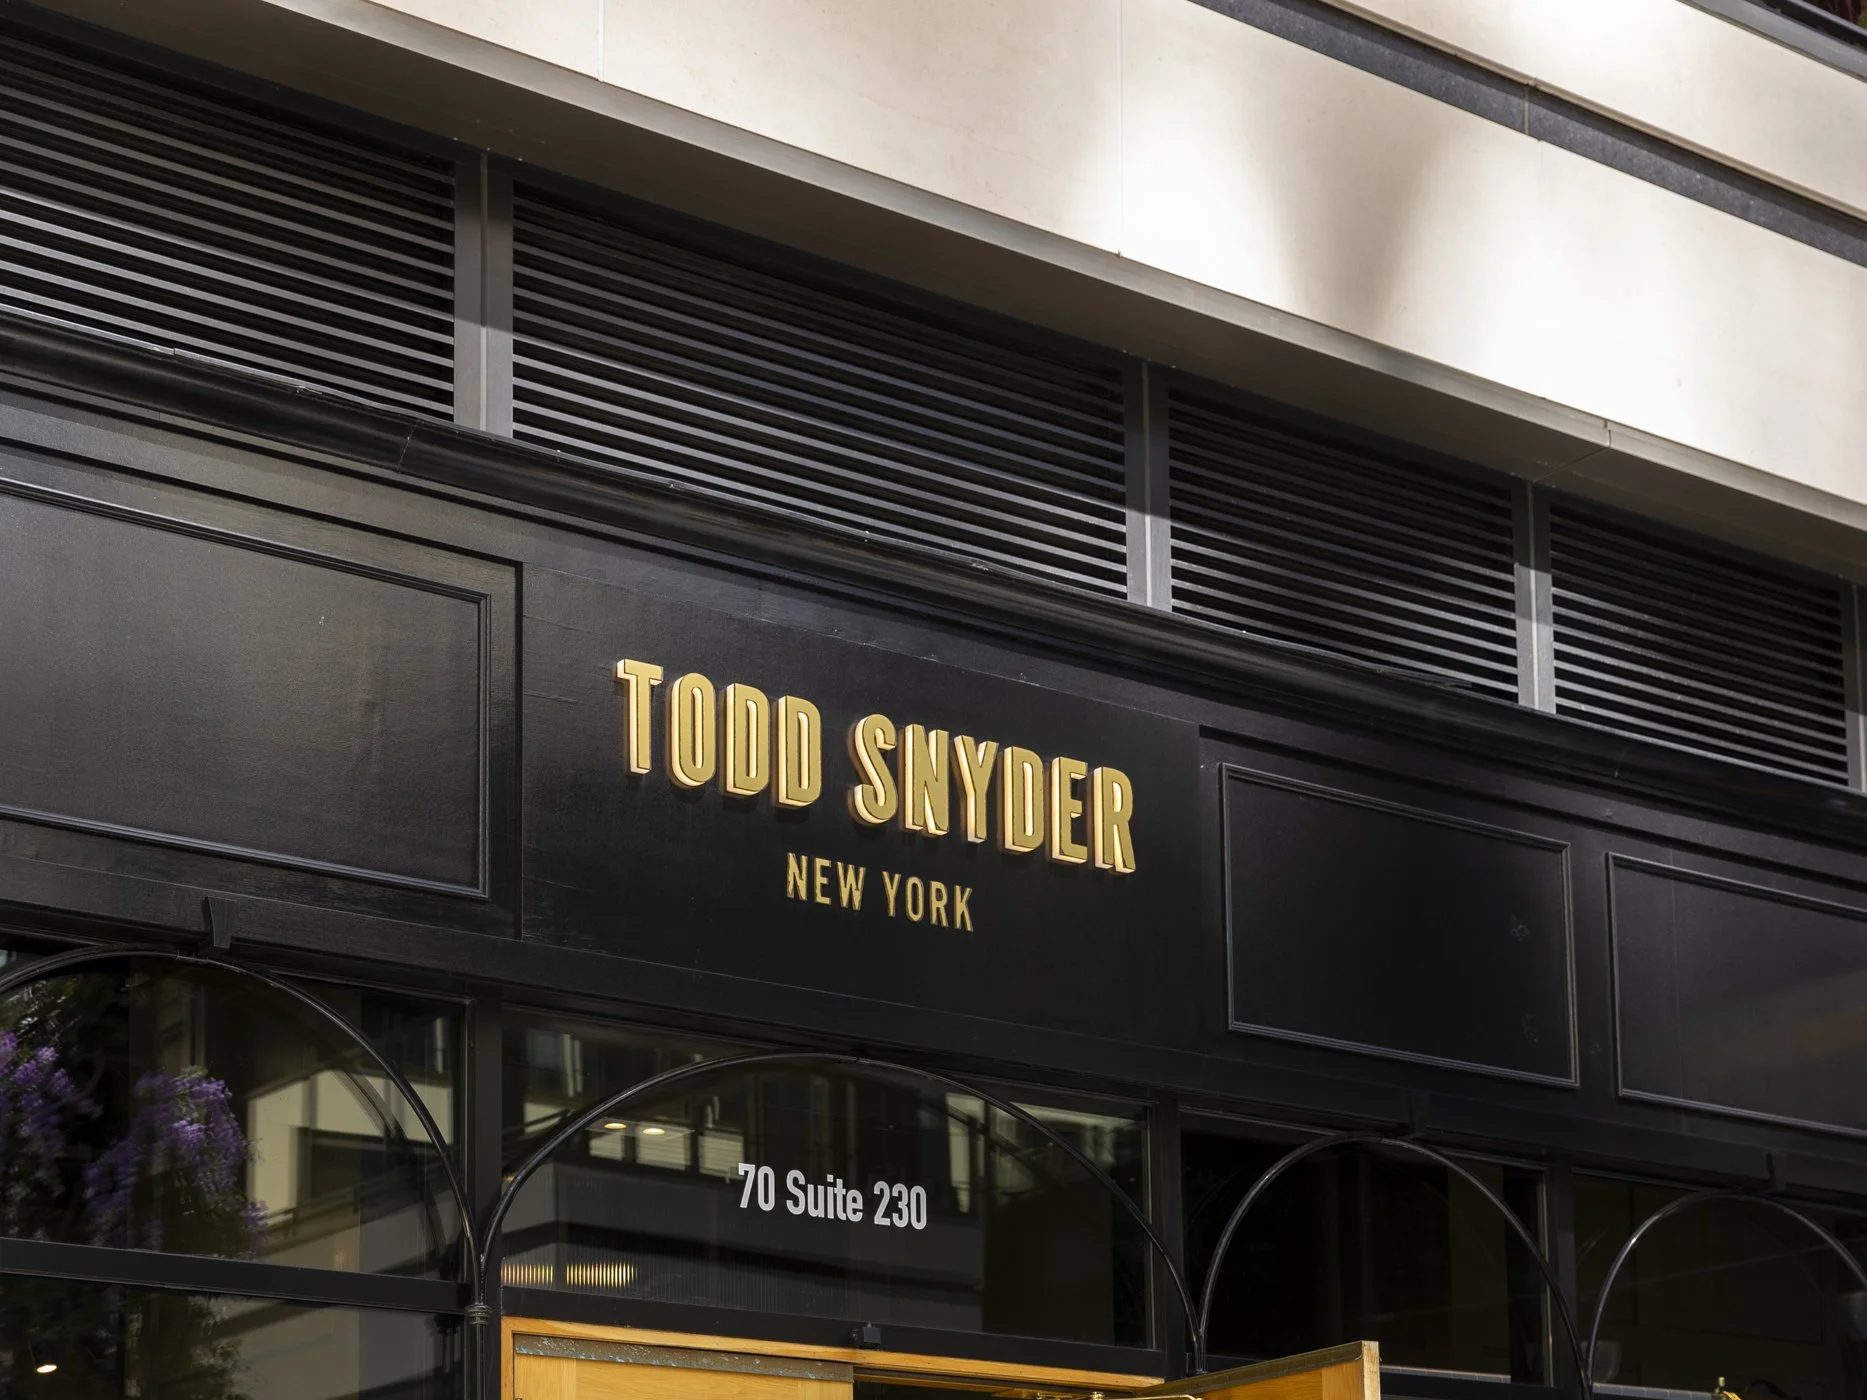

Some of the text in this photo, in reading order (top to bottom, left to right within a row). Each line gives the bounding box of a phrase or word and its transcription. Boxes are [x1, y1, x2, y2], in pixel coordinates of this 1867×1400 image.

[616, 658, 1136, 874] TODD SNYDER
[786, 852, 975, 932] NEW YORK
[738, 1162, 928, 1230] 70 Suite 230
